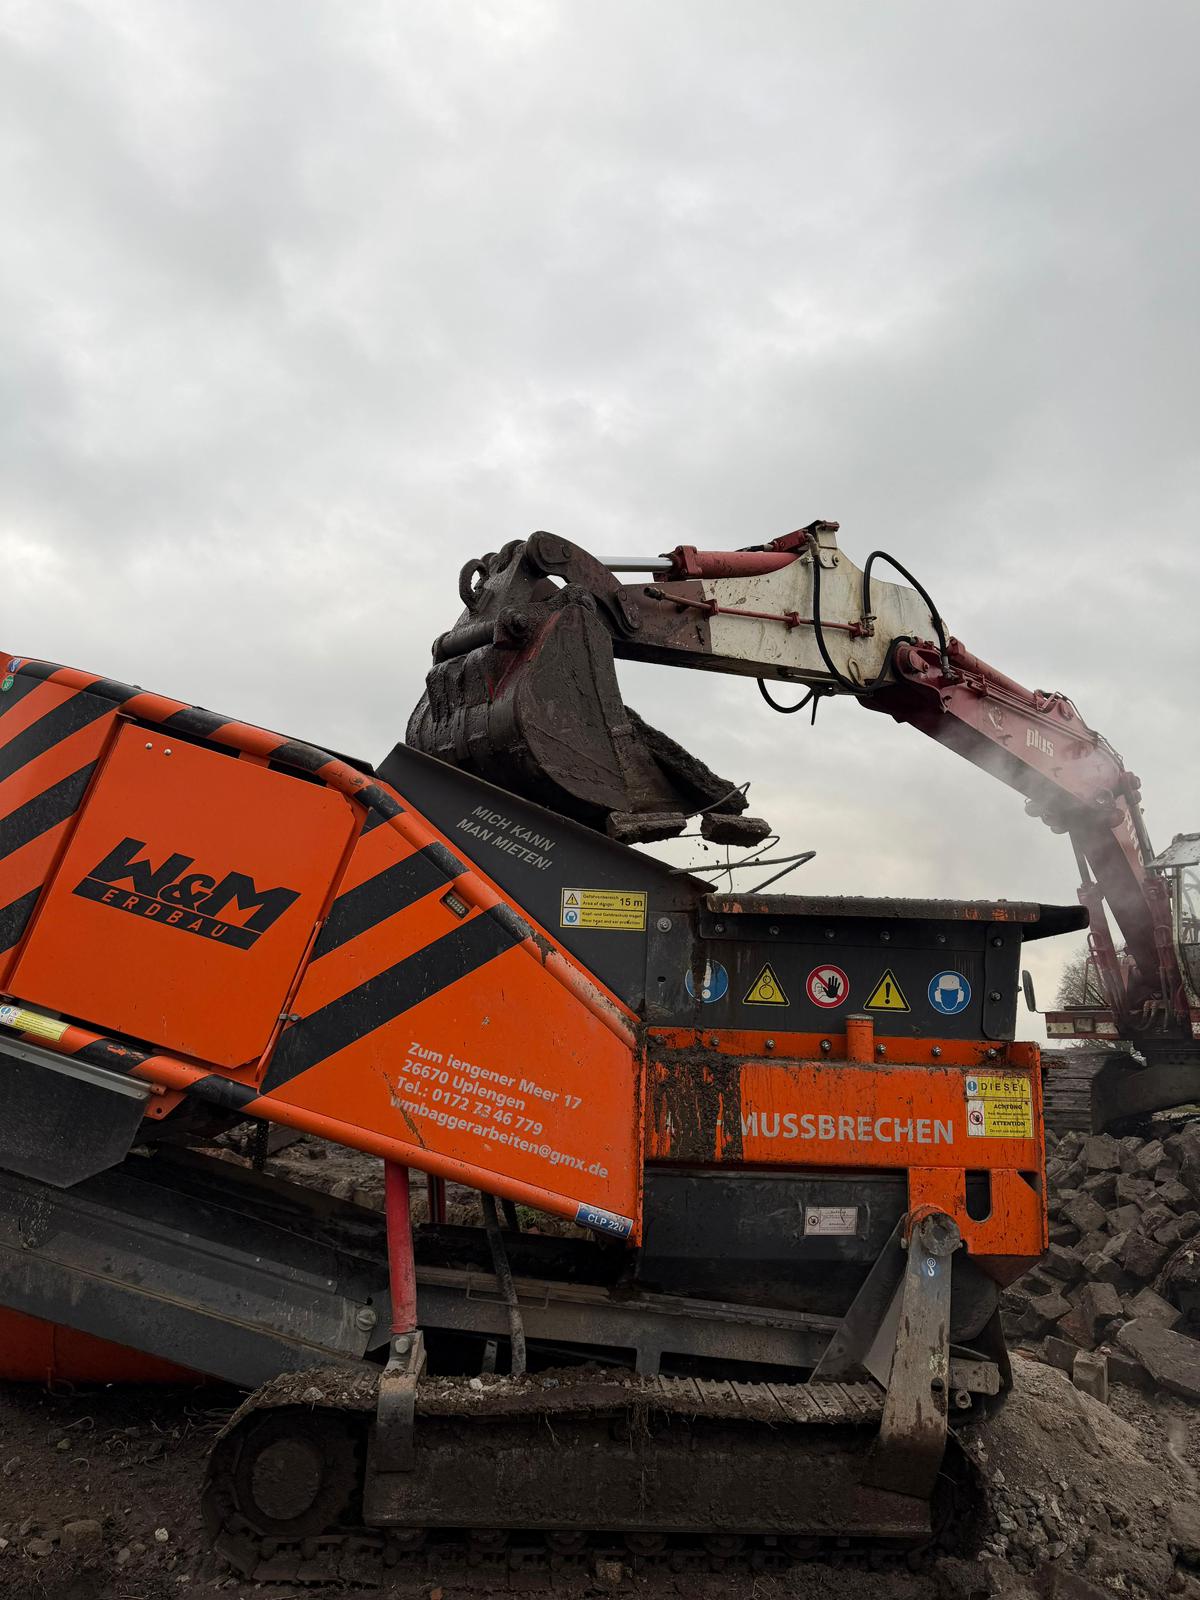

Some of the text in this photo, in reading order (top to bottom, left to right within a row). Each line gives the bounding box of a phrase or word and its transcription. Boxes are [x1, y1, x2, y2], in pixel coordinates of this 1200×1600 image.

[1026, 728, 1054, 757] plus
[456, 819, 553, 870] MAN MIETEN!
[472, 806, 556, 851] MICH KANN
[87, 837, 302, 934] W&M
[620, 897, 631, 907] 15
[102, 889, 228, 938] ERDBAU
[402, 1060, 526, 1110] 26670 Uplengen
[407, 1042, 443, 1064] Zum
[518, 1079, 560, 1102] Meer
[564, 1093, 583, 1110] 17
[981, 1082, 1027, 1092] DIESEL
[397, 1076, 544, 1136] Tel.: 0172 73 46 779
[740, 1111, 954, 1145] MUSSBRECHEN
[390, 1096, 609, 1179] wmbaggerarbeiten@gmx.de
[587, 1213, 607, 1226] CLP
